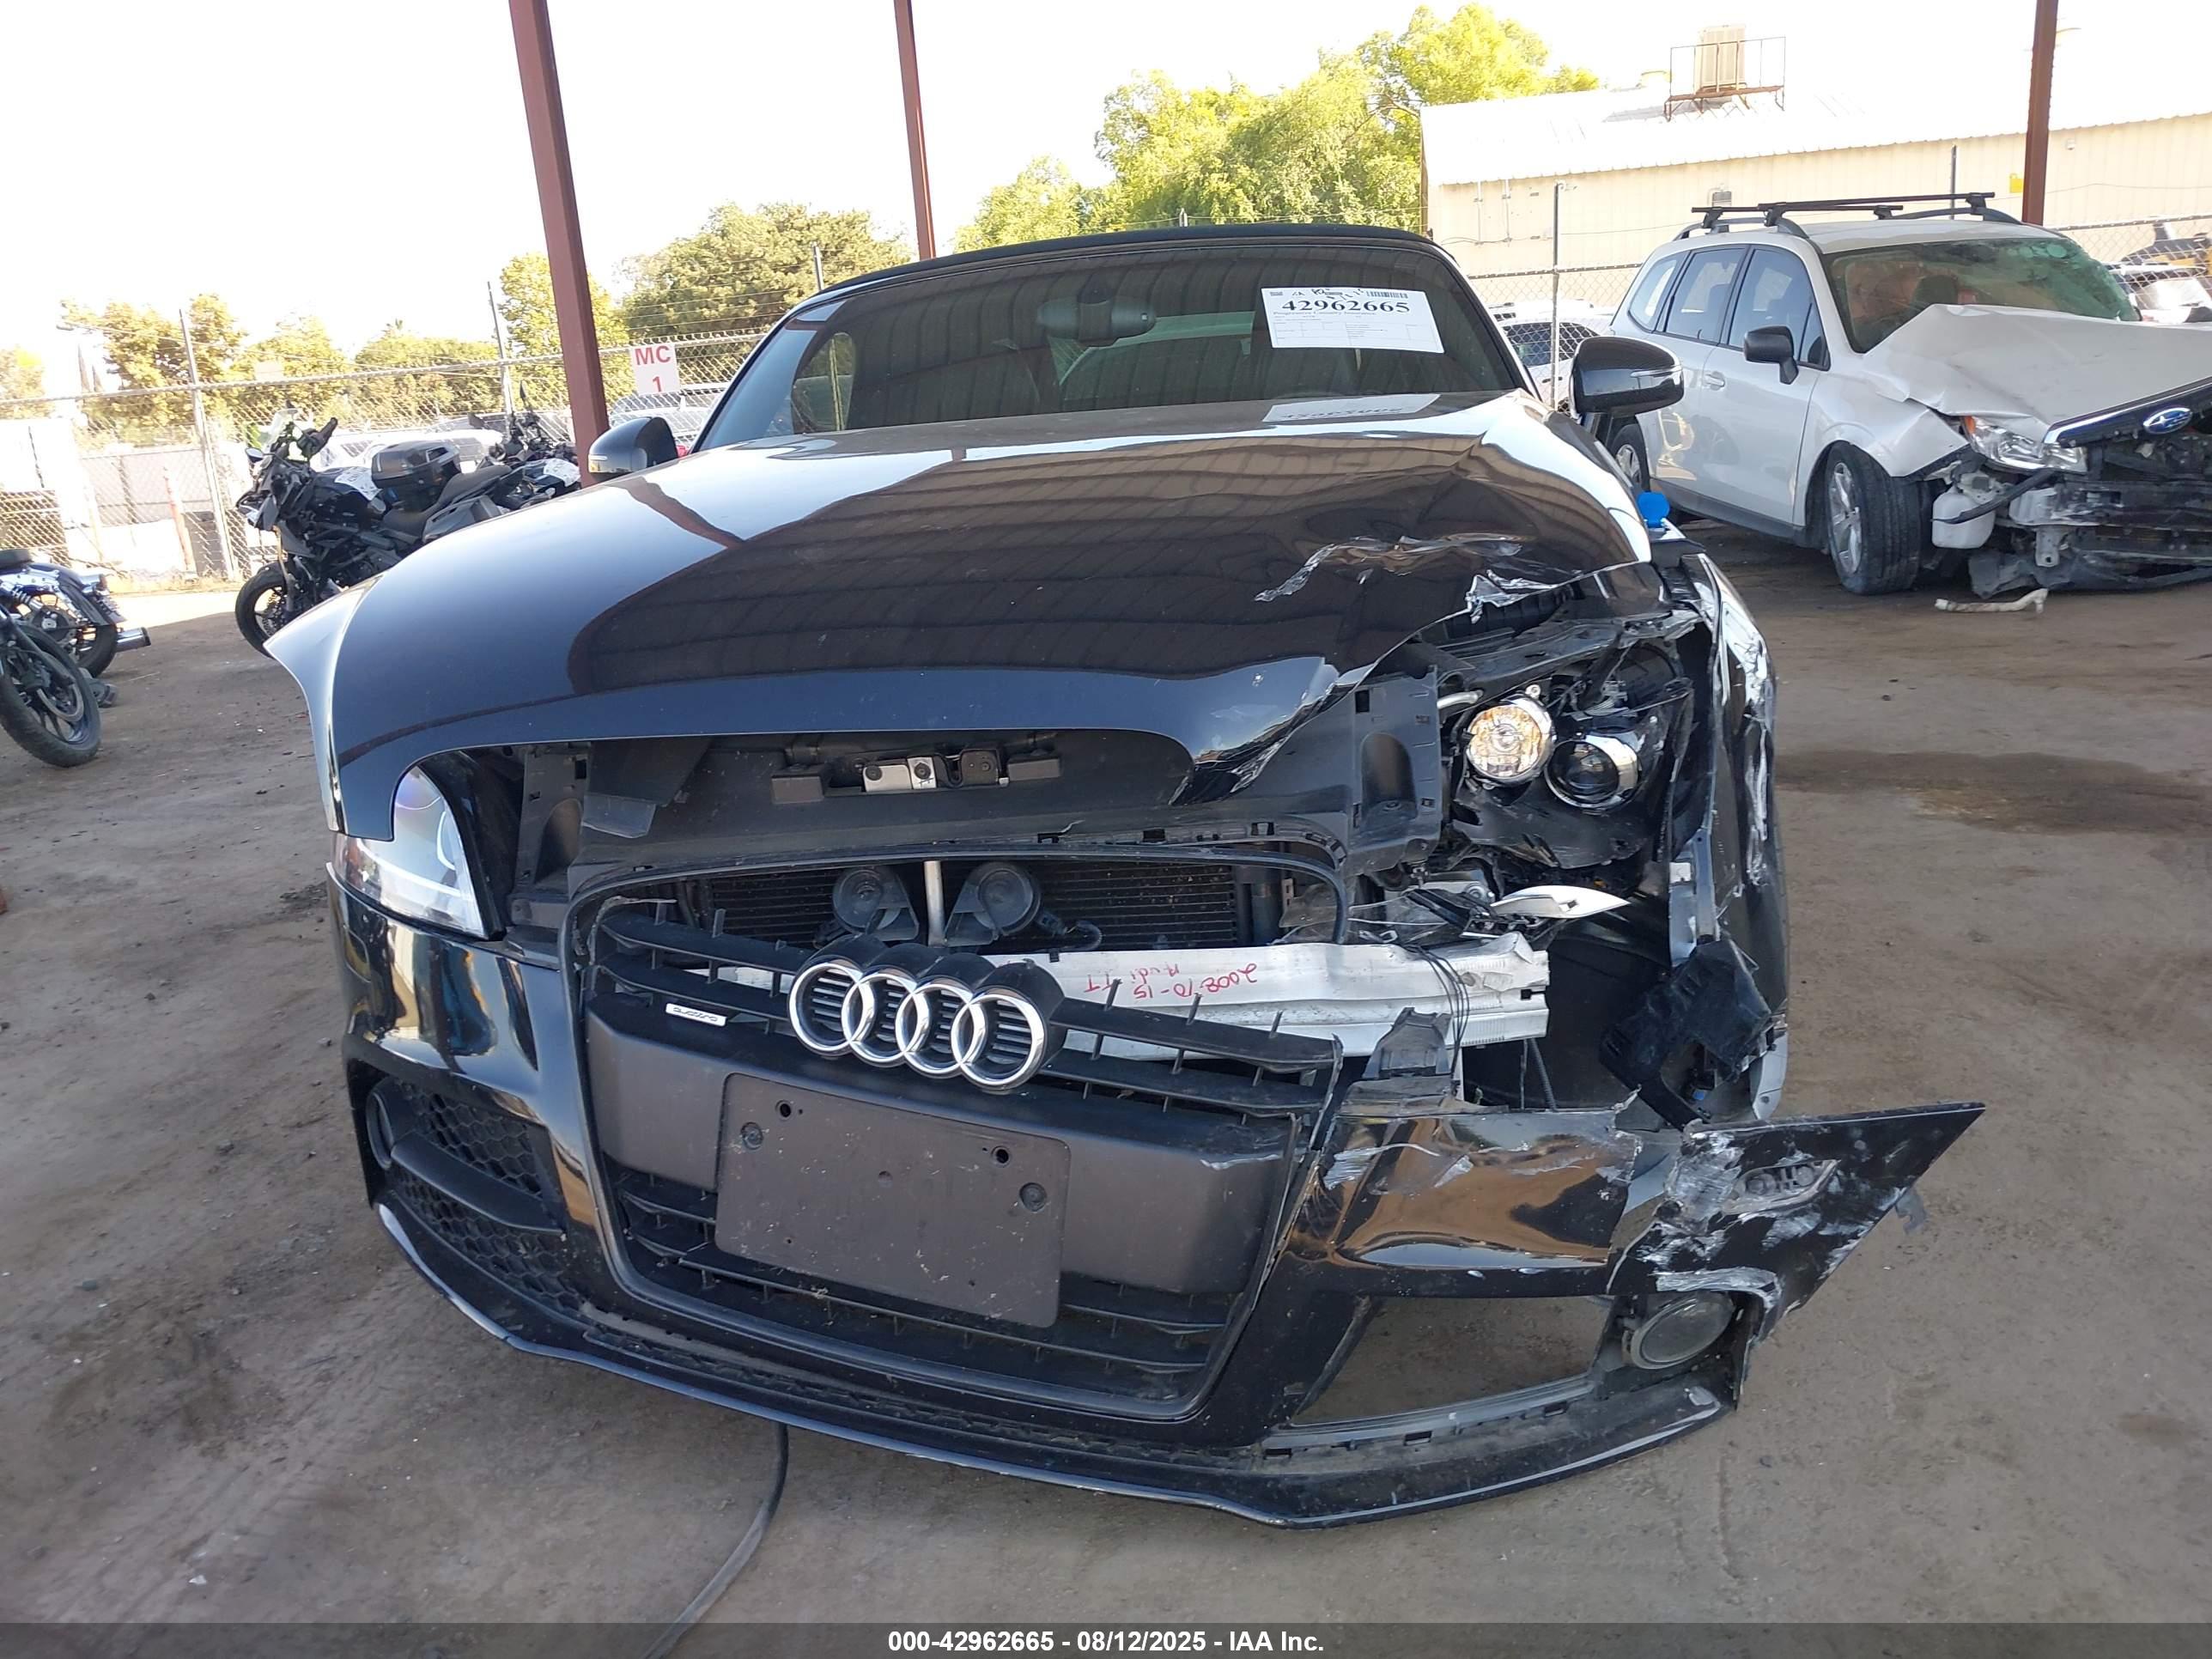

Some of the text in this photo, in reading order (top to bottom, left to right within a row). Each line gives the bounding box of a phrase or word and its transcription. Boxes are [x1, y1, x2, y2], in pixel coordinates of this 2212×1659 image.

[1282, 301, 1410, 313] 42962665
[635, 345, 672, 365] MC
[653, 376, 662, 392] 1
